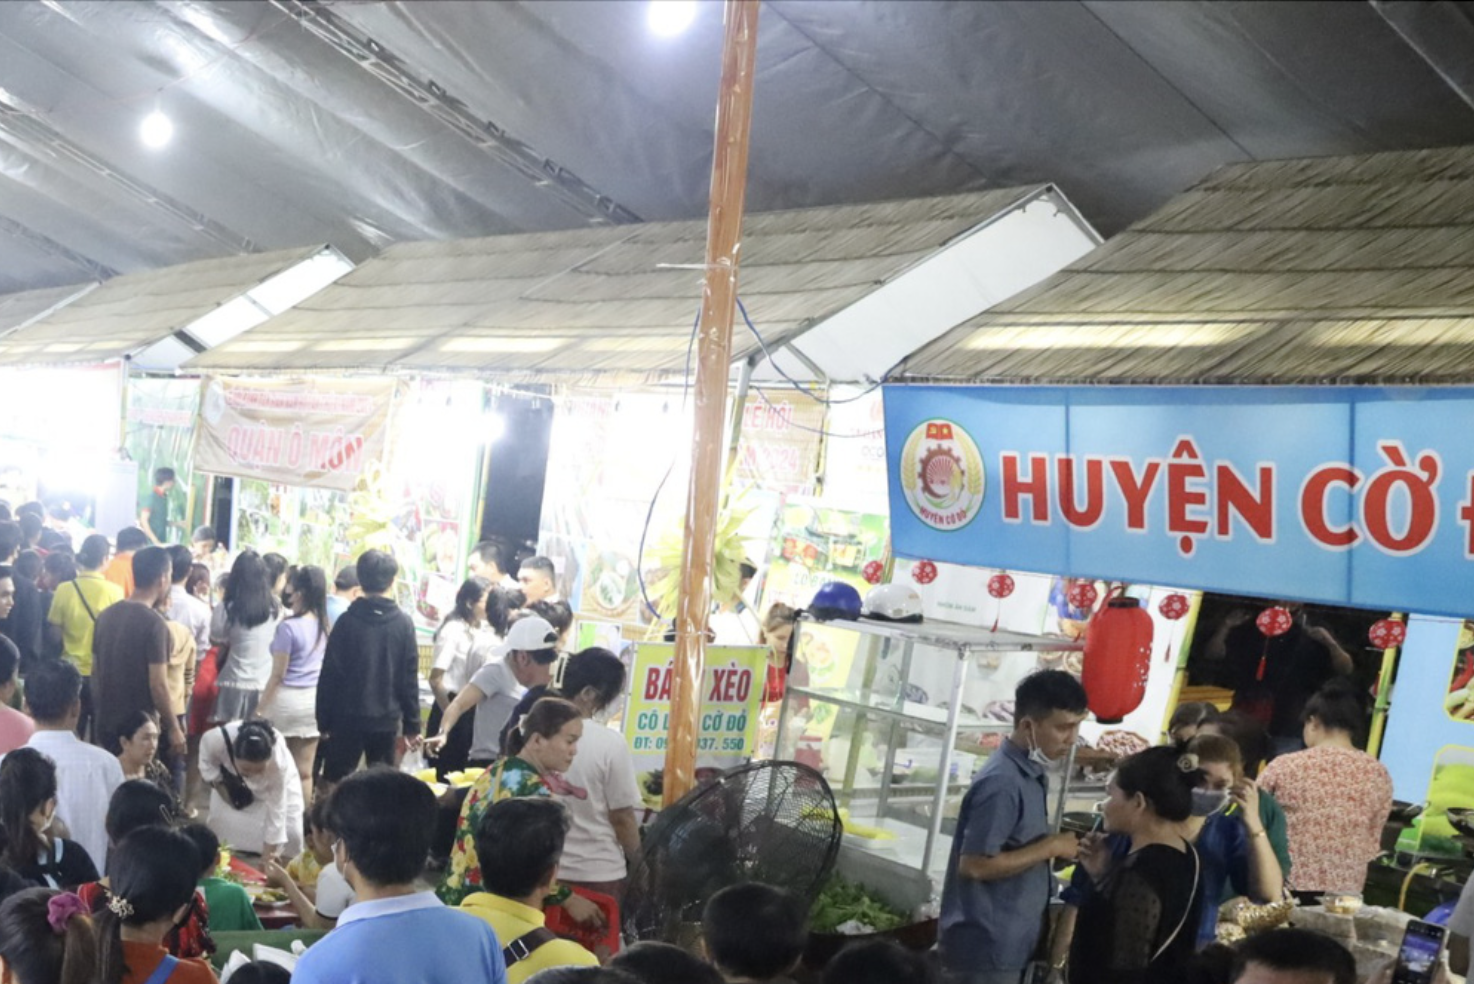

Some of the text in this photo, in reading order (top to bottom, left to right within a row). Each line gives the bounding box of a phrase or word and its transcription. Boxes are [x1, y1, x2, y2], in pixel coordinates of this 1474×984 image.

[1001, 438, 1275, 556] HUYỆN
[1301, 443, 1439, 555] CỜ
[709, 662, 752, 702] XÈO
[637, 709, 659, 731] CÔ
[722, 738, 745, 750] 550
